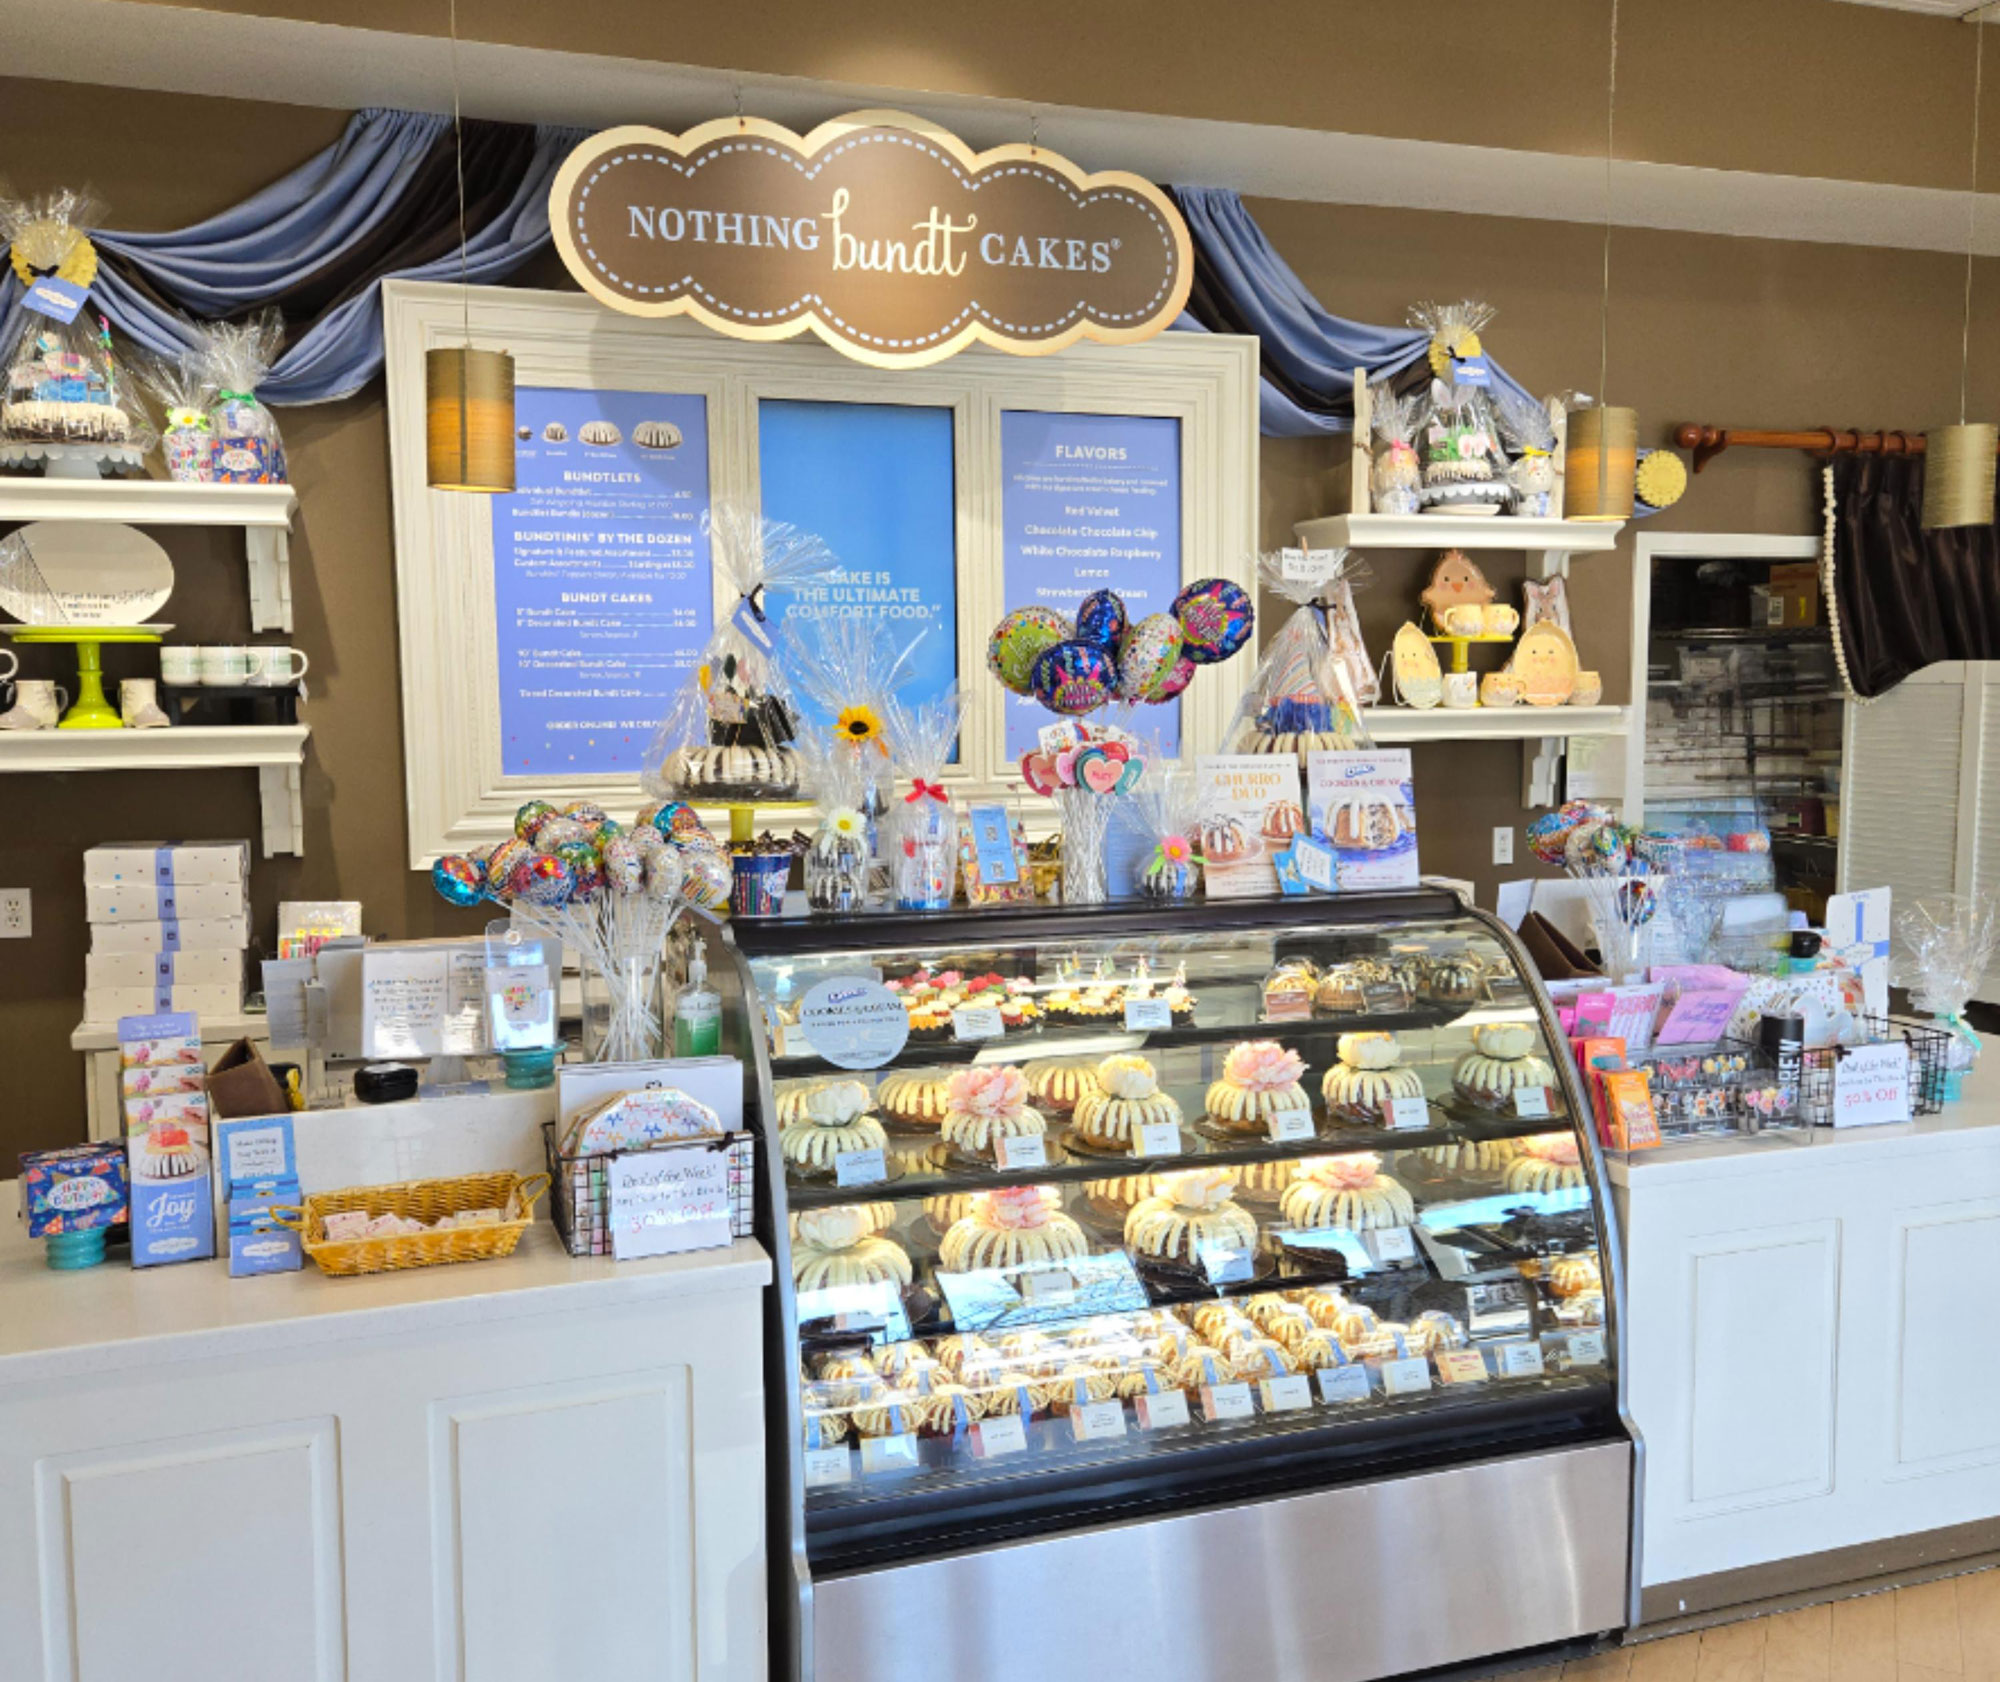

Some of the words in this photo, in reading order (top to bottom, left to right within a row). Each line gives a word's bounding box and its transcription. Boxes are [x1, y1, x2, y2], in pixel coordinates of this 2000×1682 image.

[628, 204, 820, 251] NOTHING
[822, 187, 978, 277] bundt
[1055, 445, 1128, 461] FLAVORS
[563, 470, 642, 483] BUNDTLETS
[1065, 505, 1084, 515] Red
[1086, 506, 1120, 516] Velvet
[598, 532, 615, 543] BY
[616, 532, 644, 544] THE
[647, 533, 692, 544] DOZEN
[1025, 524, 1077, 536] Chocolate
[1081, 525, 1131, 537] Chocolate
[1134, 527, 1158, 540] Chip
[1020, 544, 1054, 556] White
[1056, 546, 1108, 558] Chocolate
[1110, 546, 1162, 560] Raspberry
[824, 571, 872, 585] CAKE
[876, 571, 891, 584] IS
[1074, 567, 1110, 578] Lemon
[561, 592, 607, 603] BUNDT
[610, 593, 653, 603] CAKES
[794, 587, 829, 602] THE
[833, 588, 920, 602] ULTIMATE
[1114, 588, 1147, 598] Cream
[785, 604, 875, 619] COMFORT
[145, 1191, 195, 1228] Joy
